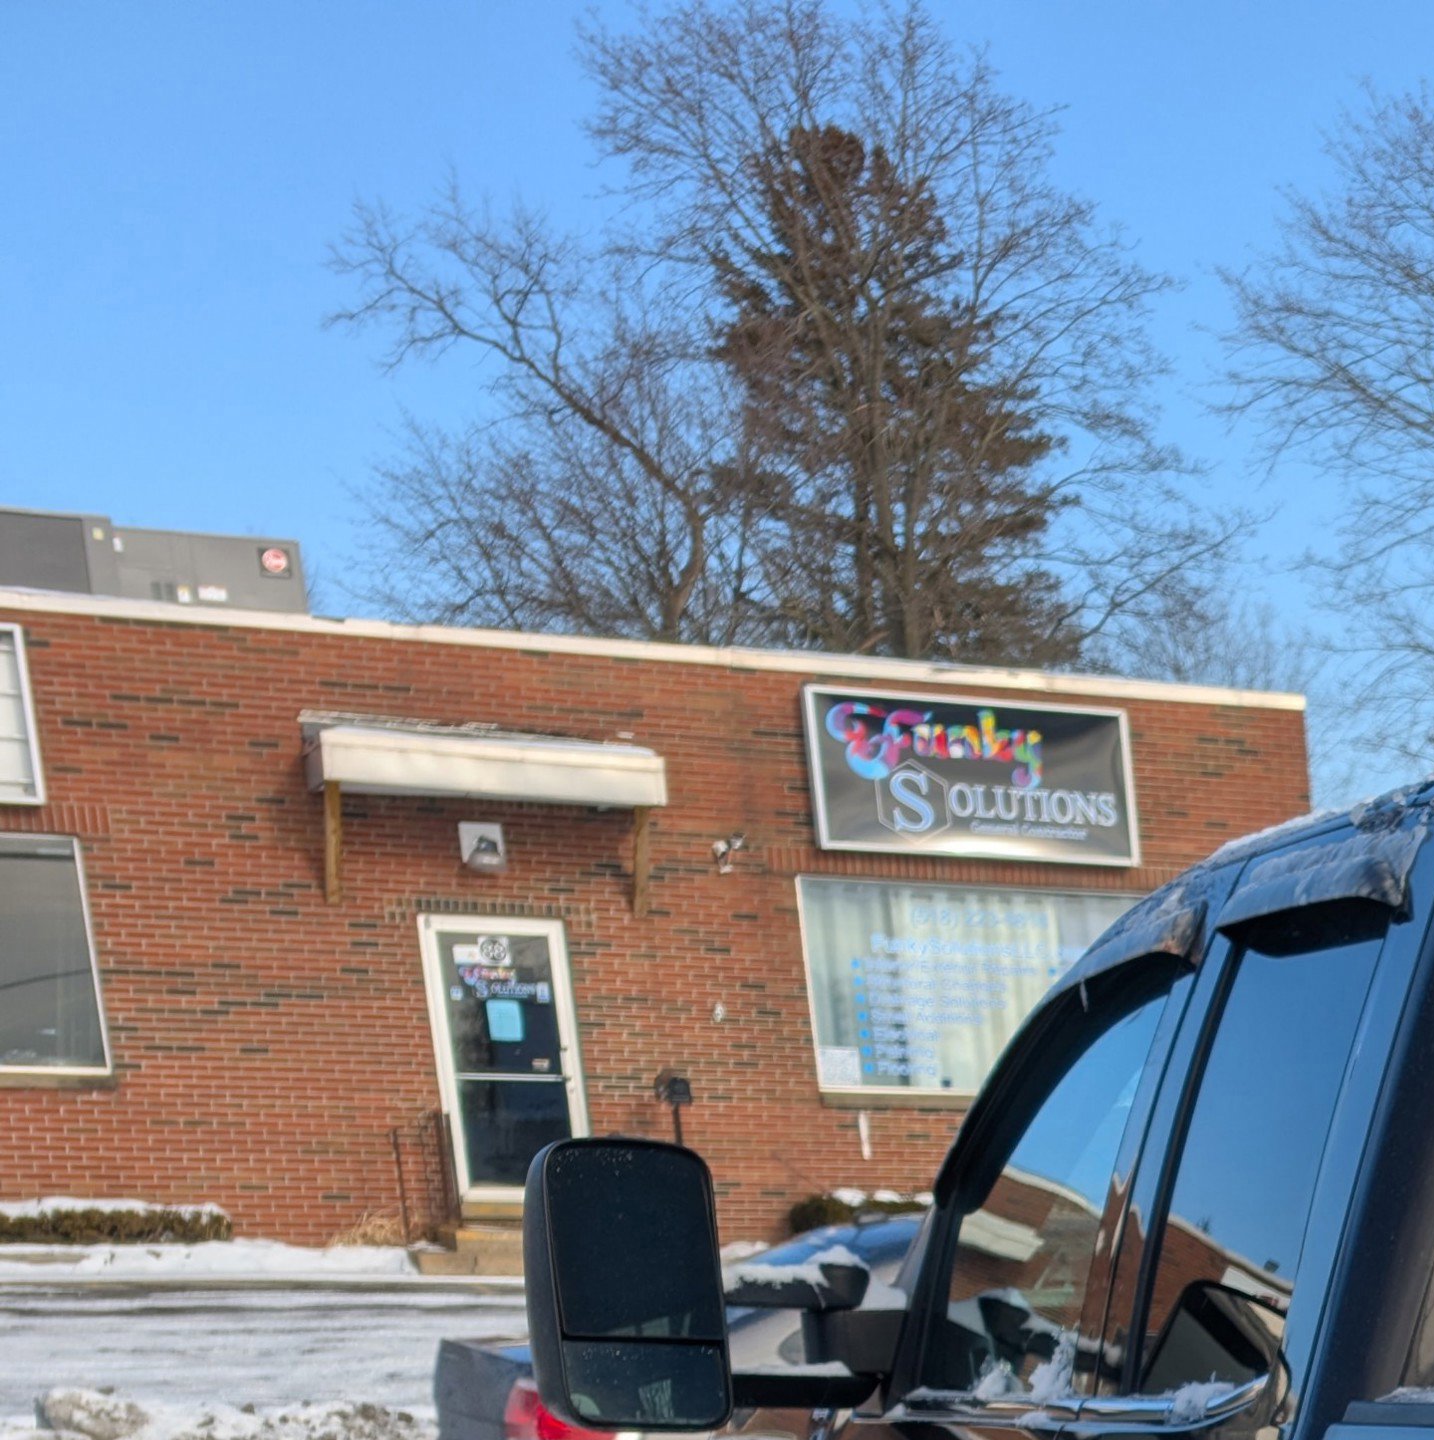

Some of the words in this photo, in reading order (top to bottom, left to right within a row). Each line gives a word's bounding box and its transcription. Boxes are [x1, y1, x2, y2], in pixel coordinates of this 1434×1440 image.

[825, 701, 1043, 789] Funky
[889, 769, 1118, 833] SOLUTIONS
[970, 819, 1019, 836] General
